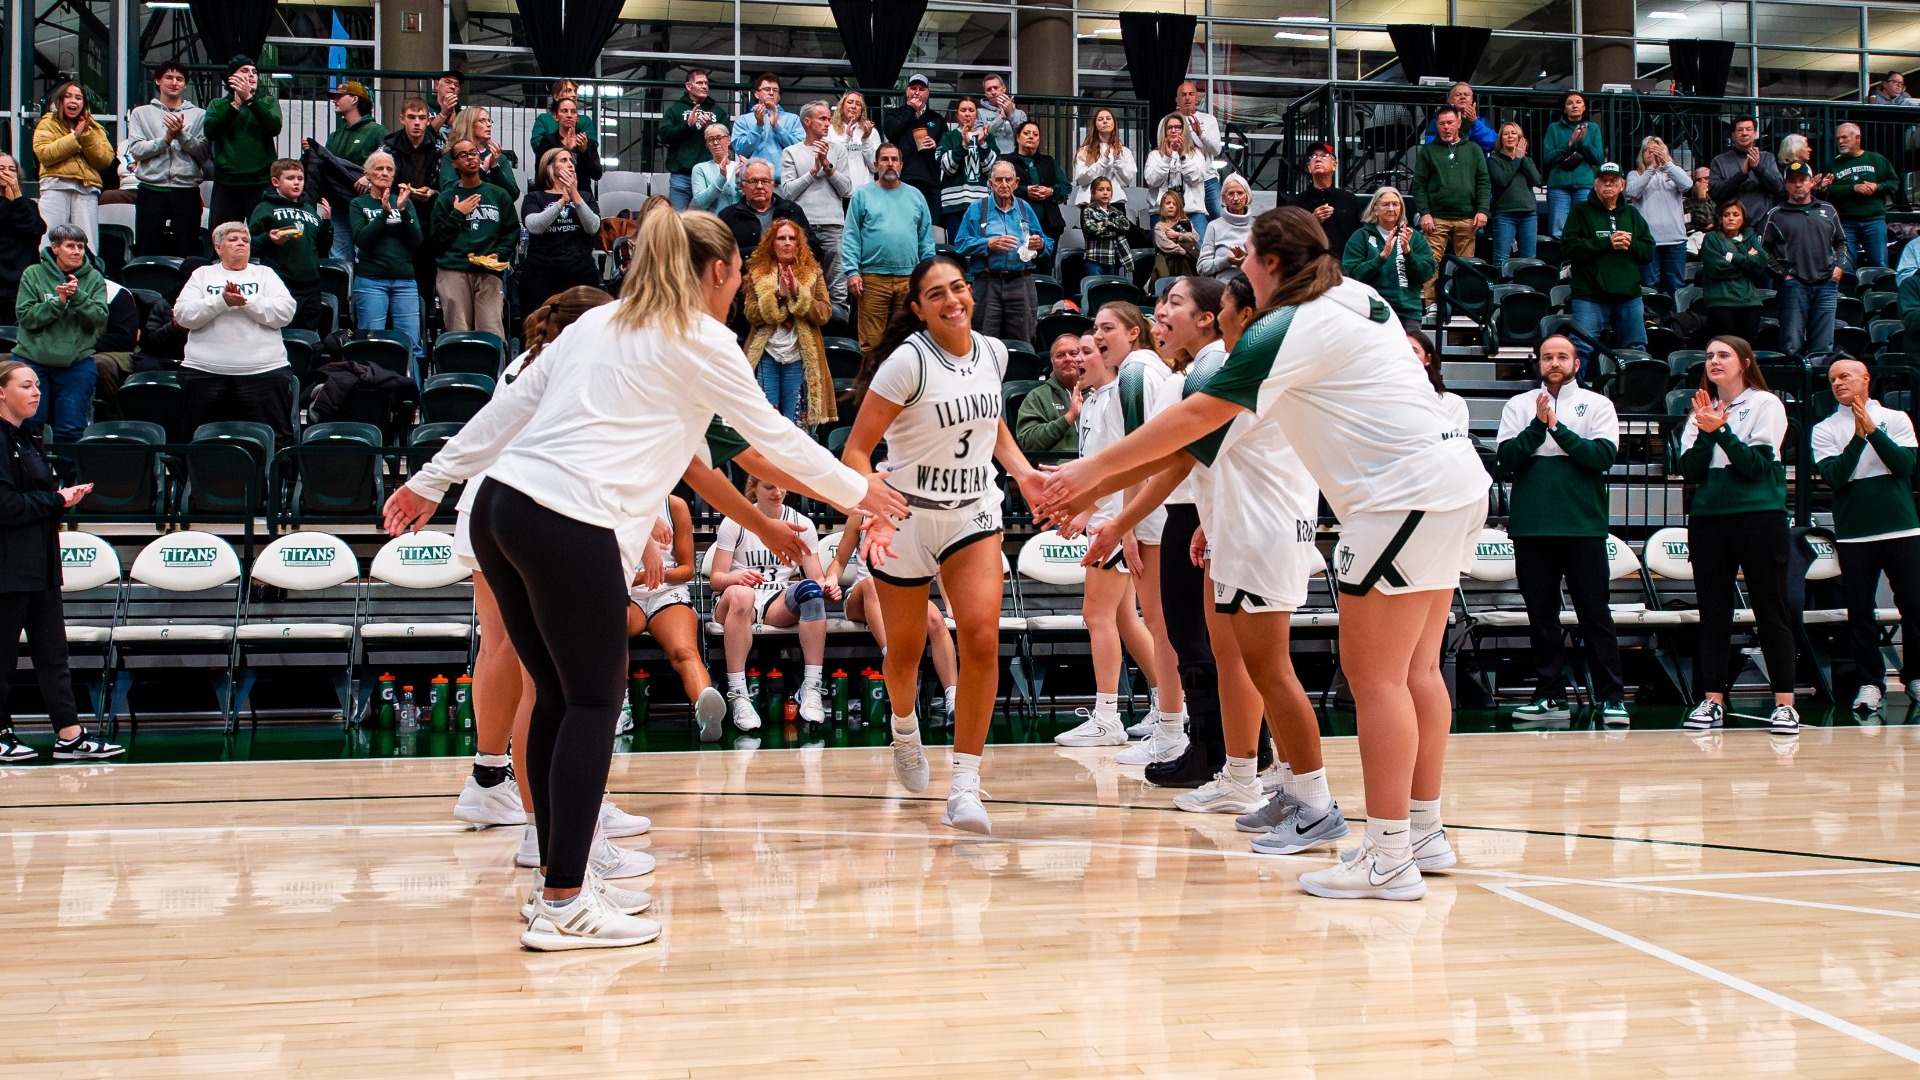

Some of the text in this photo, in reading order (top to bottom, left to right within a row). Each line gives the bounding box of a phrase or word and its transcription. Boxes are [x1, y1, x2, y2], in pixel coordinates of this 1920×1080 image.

[273, 209, 319, 227] TITANS
[935, 393, 999, 428] ILLINOIS
[954, 429, 973, 458] 3
[61, 548, 96, 562] TANS
[160, 548, 217, 562] TITANS
[280, 547, 335, 561] TITANS
[397, 545, 451, 560] TITANS
[1040, 545, 1087, 558] TITANS
[1663, 542, 1690, 554] TITA
